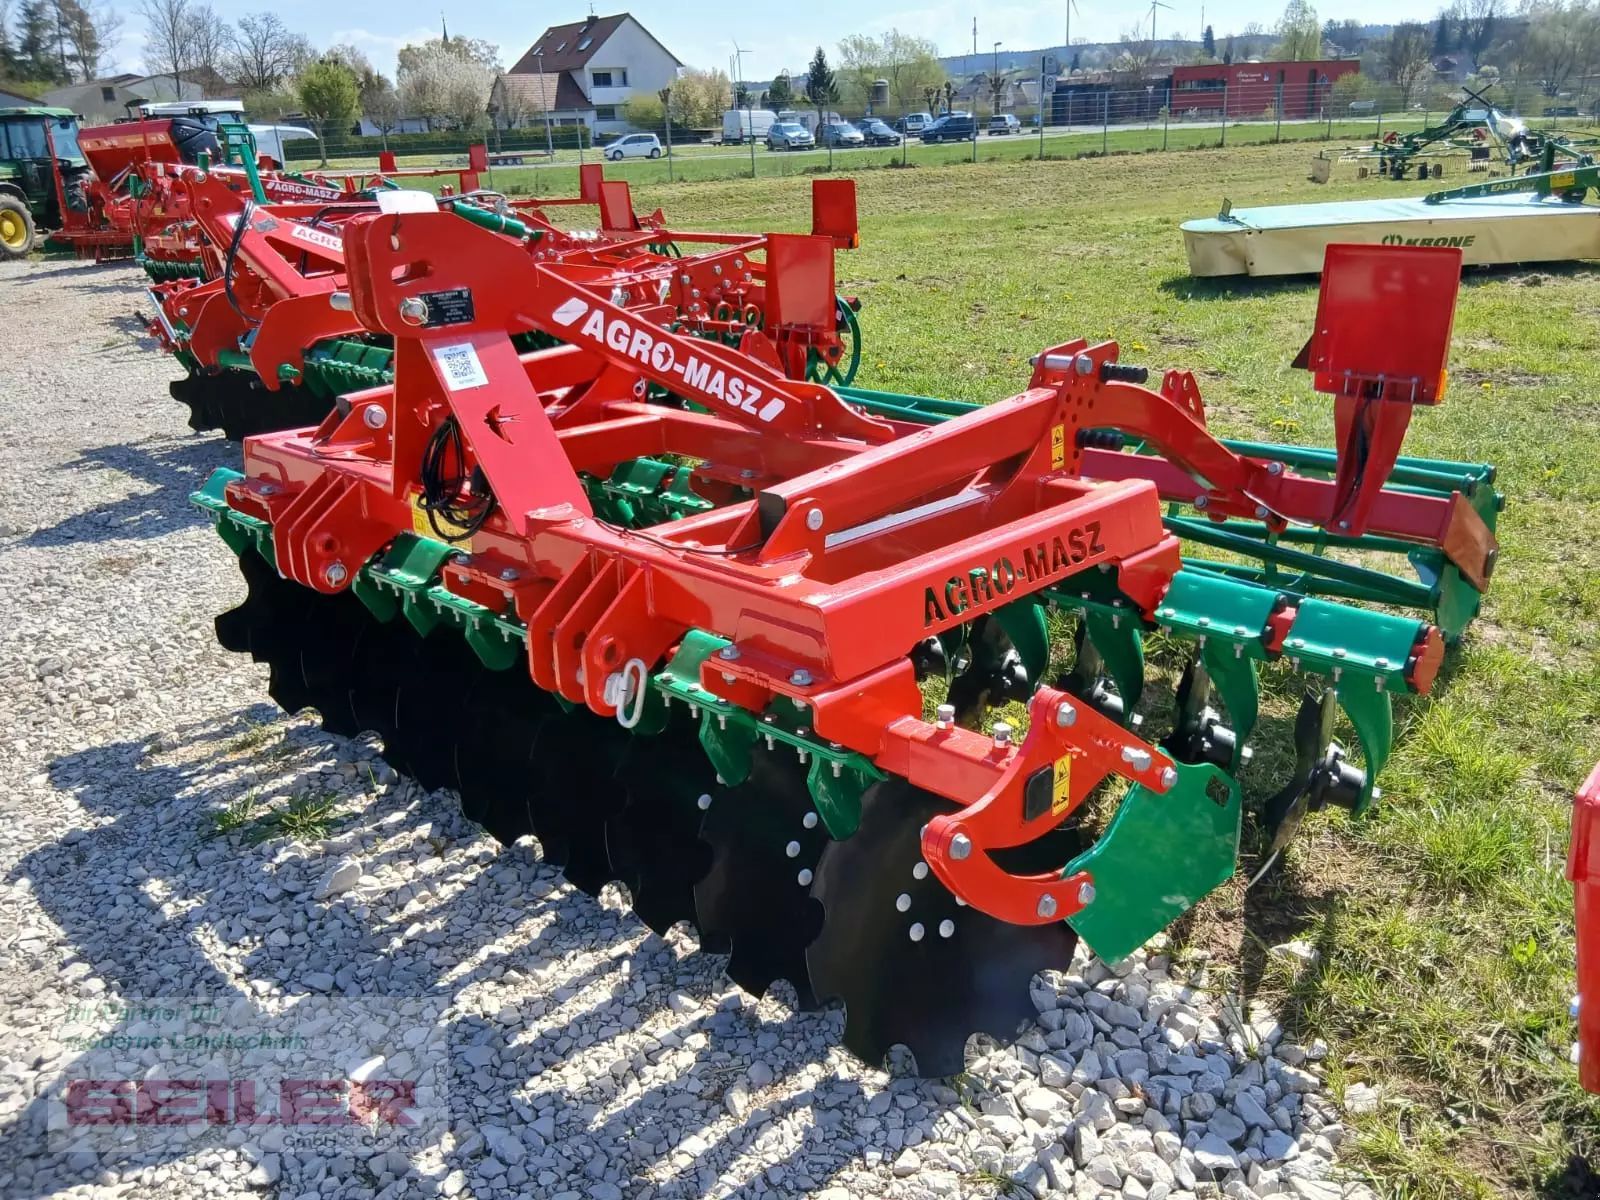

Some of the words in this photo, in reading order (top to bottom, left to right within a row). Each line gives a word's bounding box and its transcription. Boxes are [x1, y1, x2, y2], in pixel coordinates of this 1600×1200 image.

[274, 182, 332, 199] AGRO-MASZ
[1490, 182, 1518, 192] EASY
[581, 309, 762, 415] AGRO-MASZ
[924, 521, 1105, 629] AGRO-MASZ
